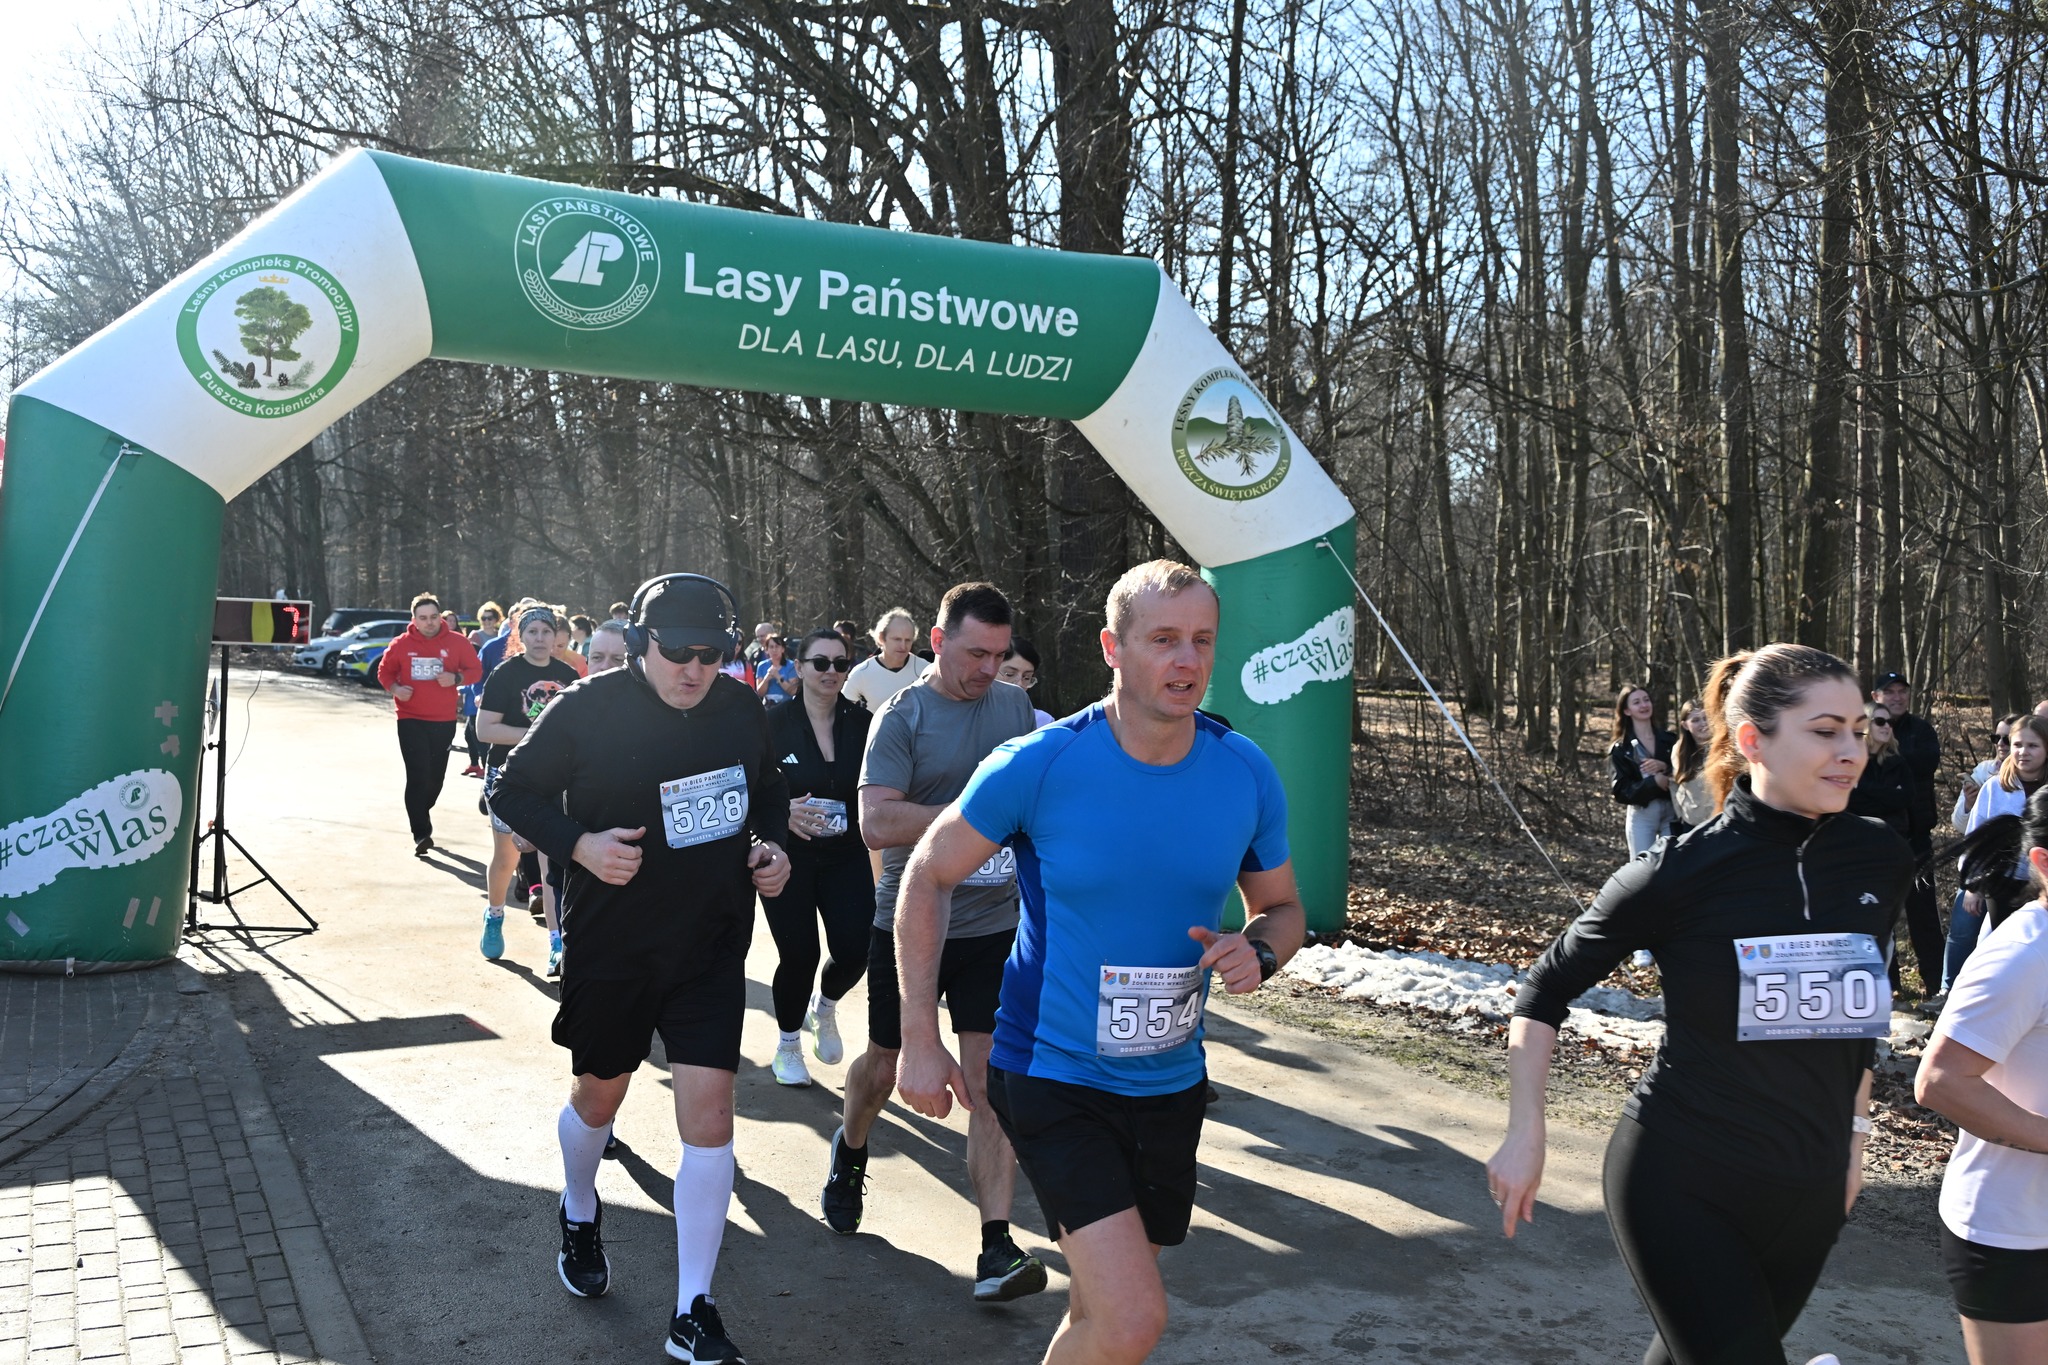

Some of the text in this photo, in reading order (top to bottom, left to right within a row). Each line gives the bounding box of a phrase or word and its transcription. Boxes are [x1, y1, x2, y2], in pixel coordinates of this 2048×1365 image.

[522, 200, 655, 262] LASY PAŃSTWOWE
[185, 256, 354, 332] Leśny Kompleks Promocyjny
[684, 252, 1080, 338] Lasy Państwowe
[738, 323, 1073, 381] DLA LASU, DLA LUDZI
[199, 370, 325, 416] Puszcza Kozienicka
[1175, 369, 1240, 431] LEŚNY KOMPLEKS
[1175, 447, 1209, 490] PUSZCZA
[1253, 636, 1324, 684] #czas
[671, 789, 744, 835] 528
[0, 808, 95, 871] #czas
[1145, 972, 1165, 980] BIEG
[1753, 968, 1878, 1022] 550
[1109, 990, 1199, 1041] 554
